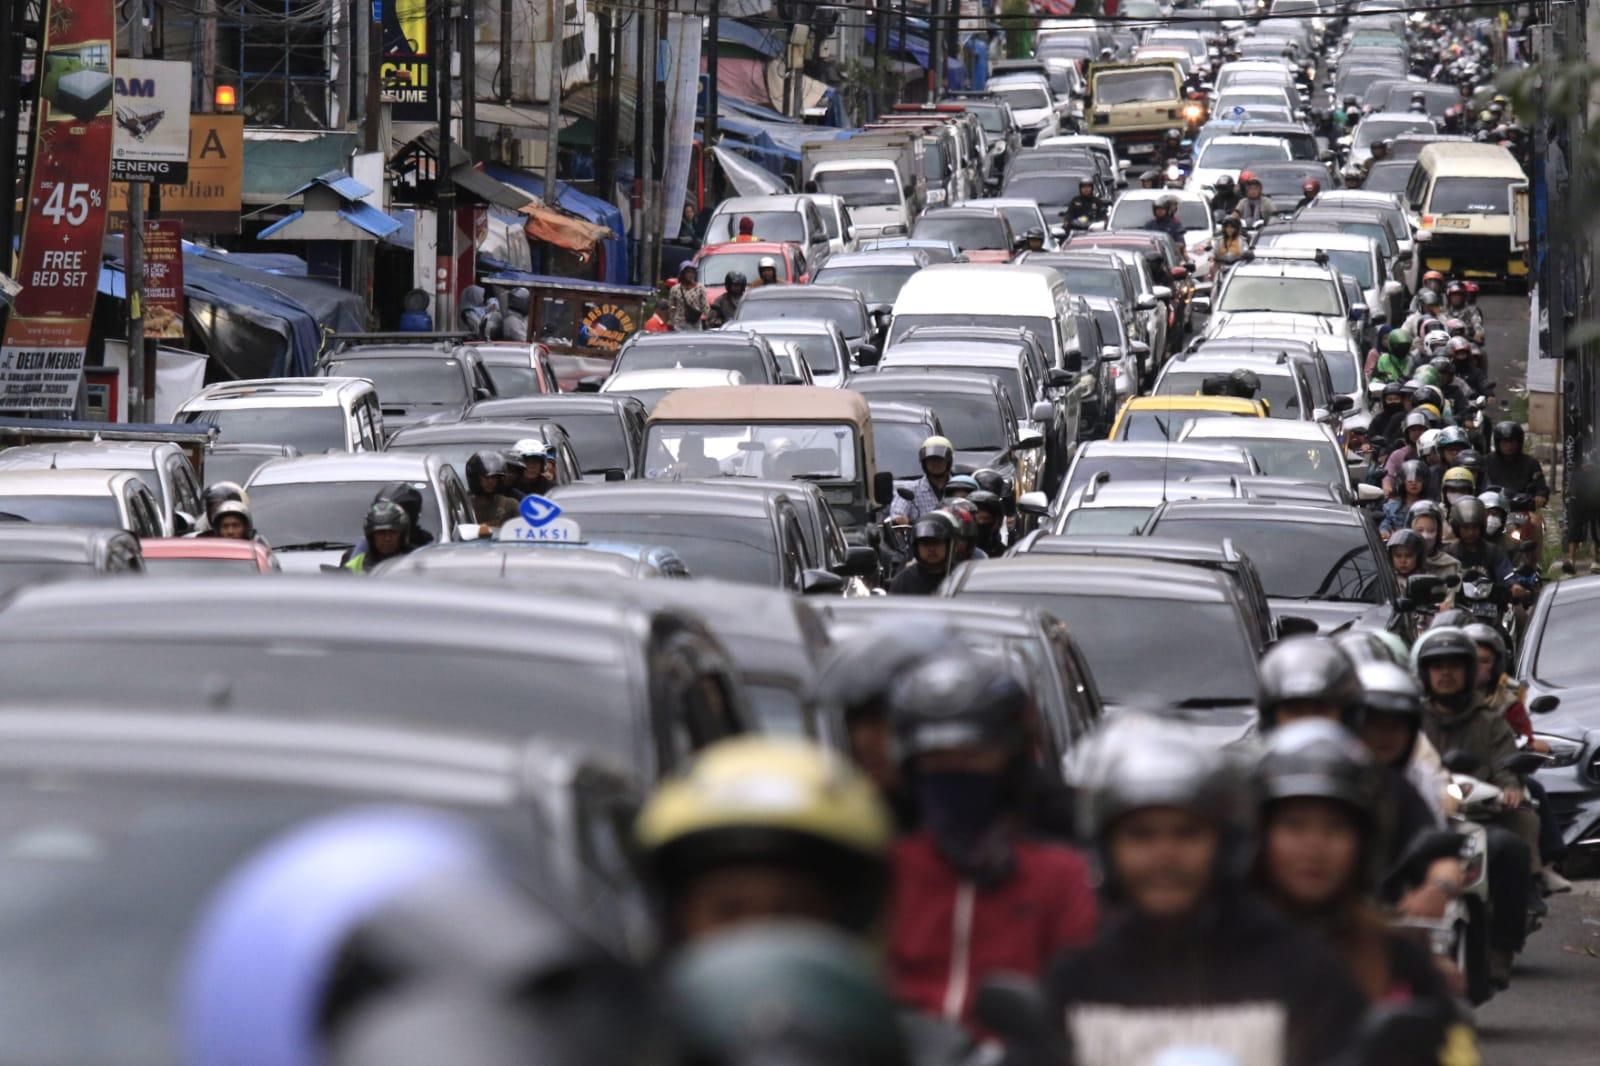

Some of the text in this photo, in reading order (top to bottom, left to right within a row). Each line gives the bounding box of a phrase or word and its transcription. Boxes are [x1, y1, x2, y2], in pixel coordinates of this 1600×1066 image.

[114, 77, 155, 97] AM
[381, 90, 428, 102] FUME
[42, 182, 101, 226] 45%
[32, 271, 88, 287] BED SET
[16, 351, 46, 370] DELTA
[45, 351, 83, 370] MEUBEL
[514, 528, 568, 540] TAKSI
